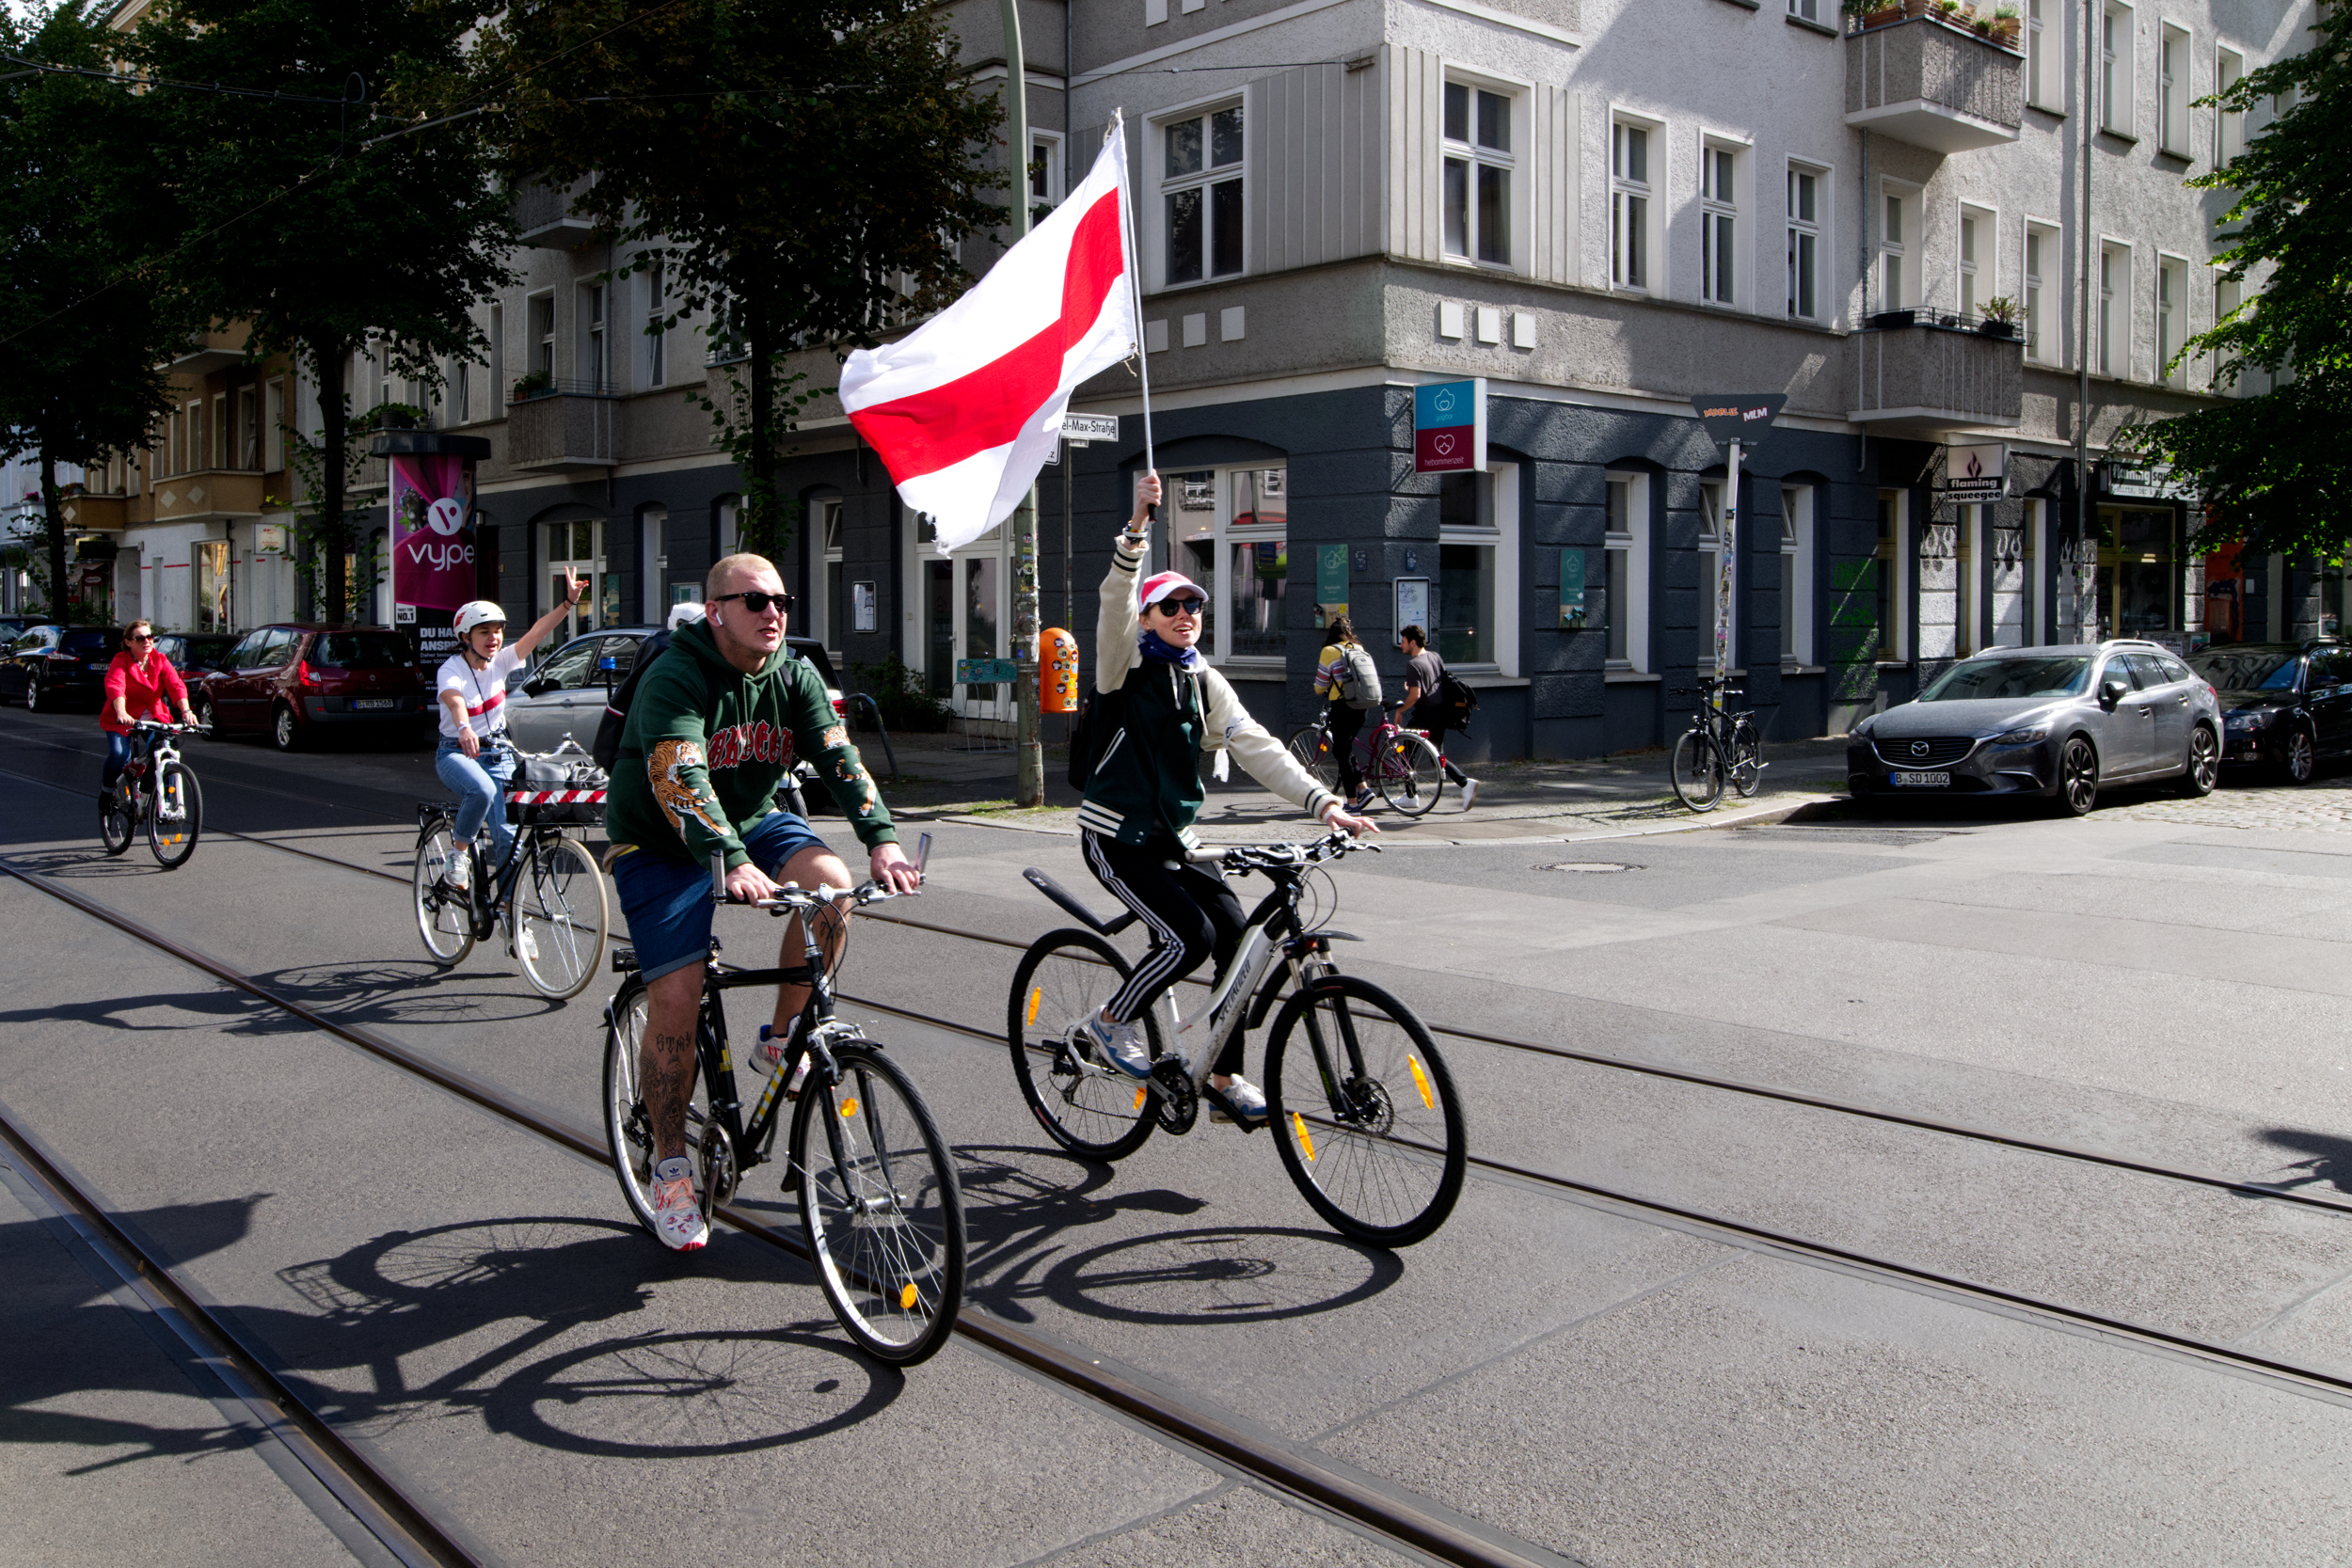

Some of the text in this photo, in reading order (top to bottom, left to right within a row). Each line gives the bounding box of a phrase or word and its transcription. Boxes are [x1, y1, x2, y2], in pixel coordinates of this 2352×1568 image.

[1742, 406, 1768, 421] MLM
[1061, 419, 1116, 436] el-Max-Straße
[1950, 478, 1997, 488] flaming
[1947, 491, 2001, 500] squeegee
[407, 544, 475, 571] vype
[397, 612, 414, 621] NO.1
[420, 627, 456, 638] DU HA
[1896, 774, 1949, 784] B SD 1002
